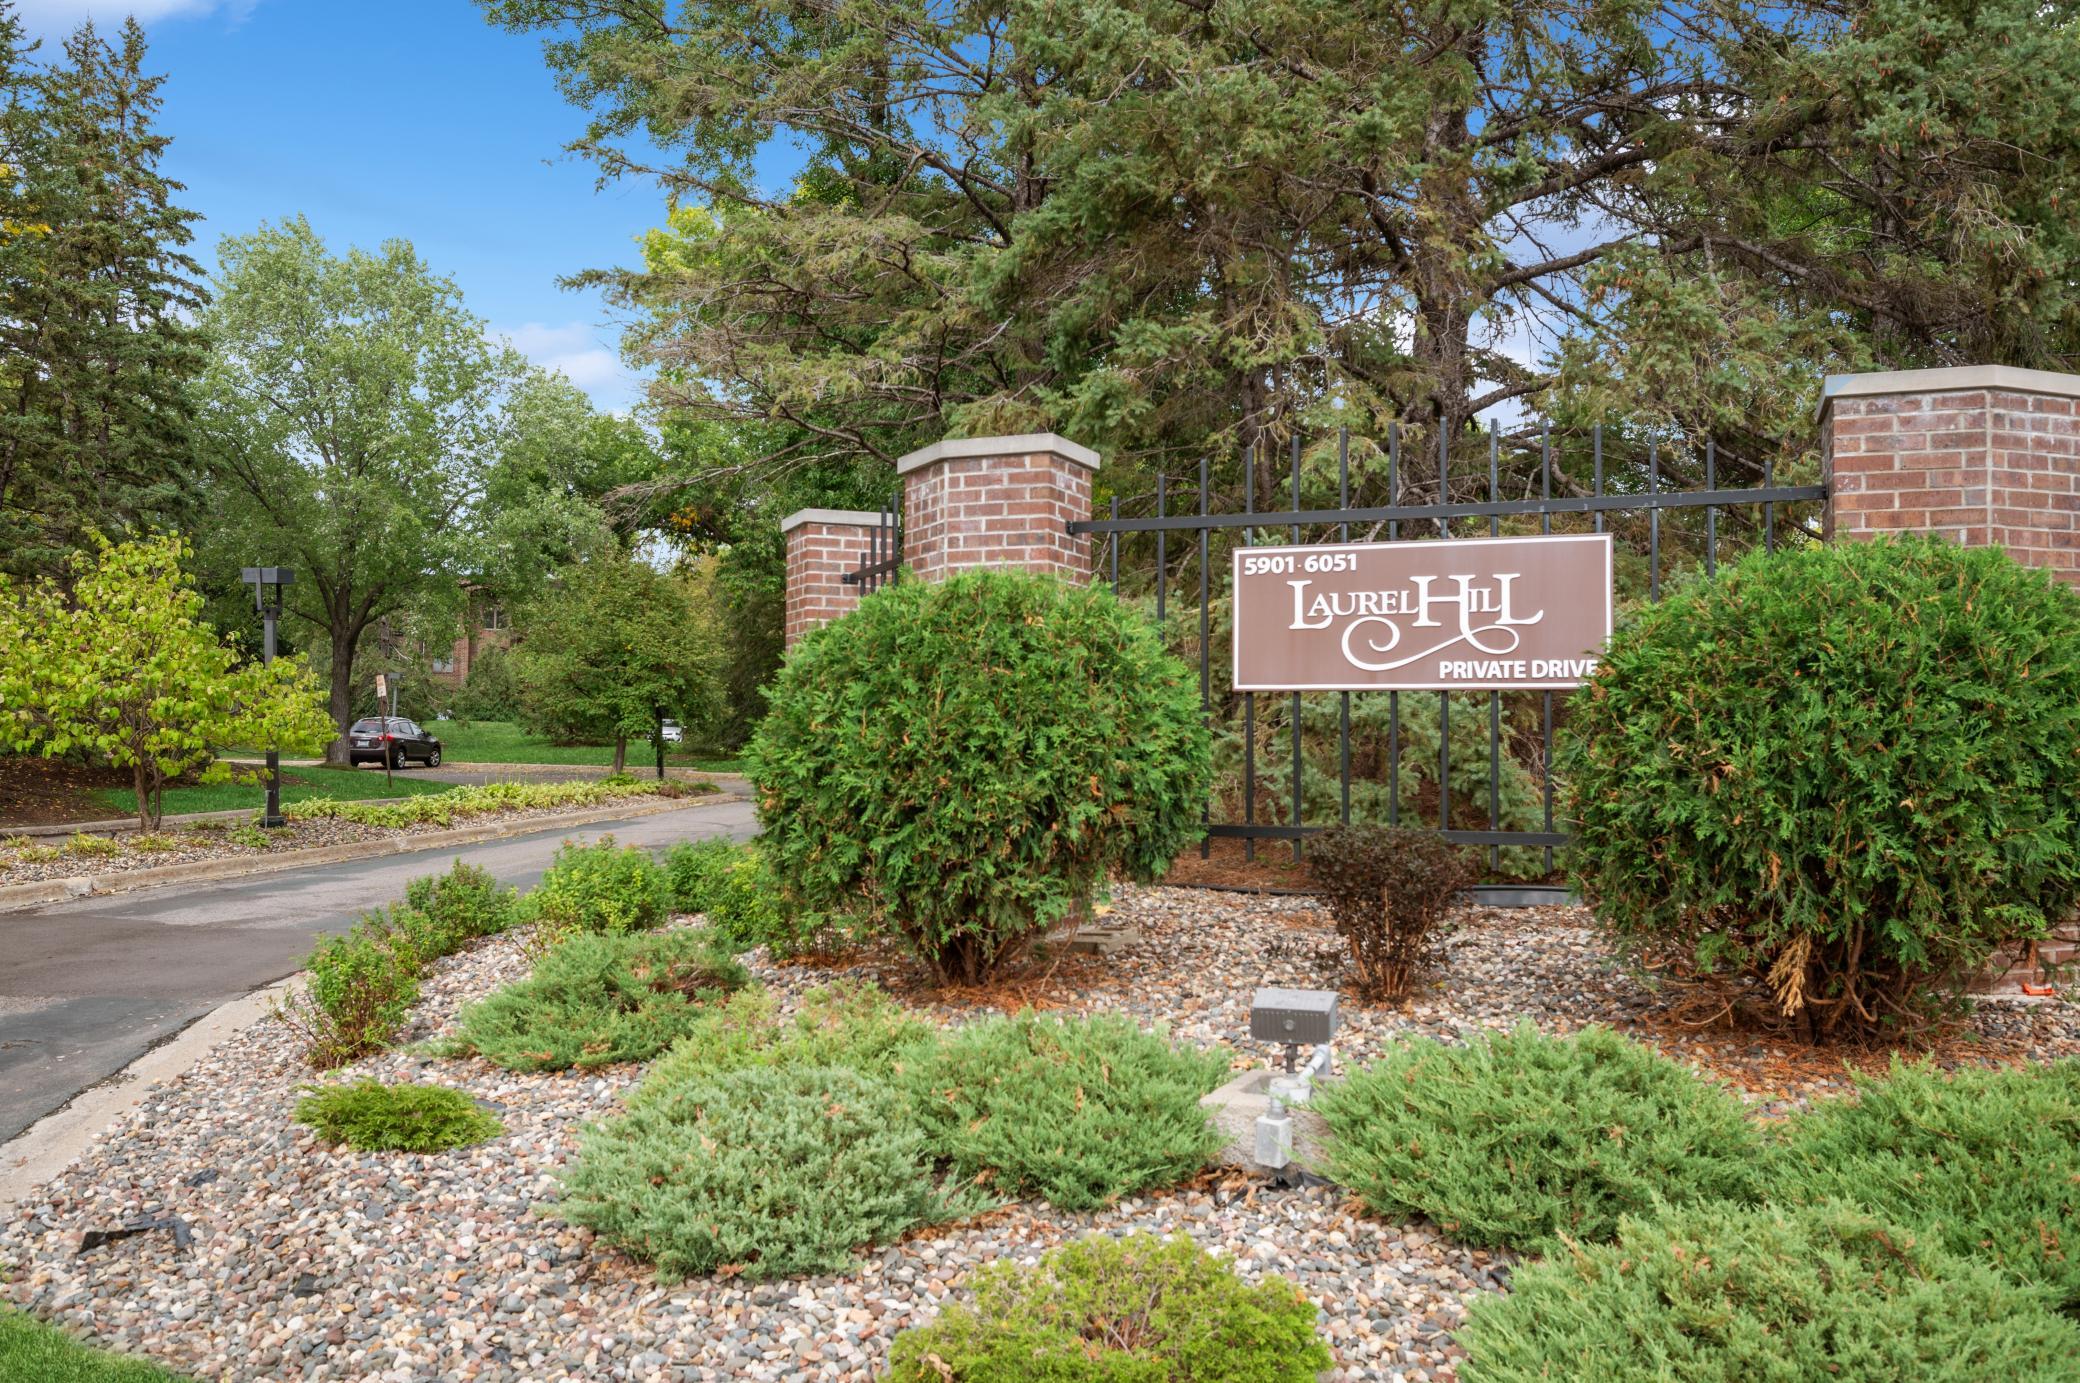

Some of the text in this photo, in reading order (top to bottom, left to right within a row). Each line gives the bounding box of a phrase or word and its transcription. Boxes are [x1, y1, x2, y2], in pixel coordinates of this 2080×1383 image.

[1286, 572, 1544, 655] LAUREL HILL
[1439, 659, 1599, 679] PRIVATE DRIVE
